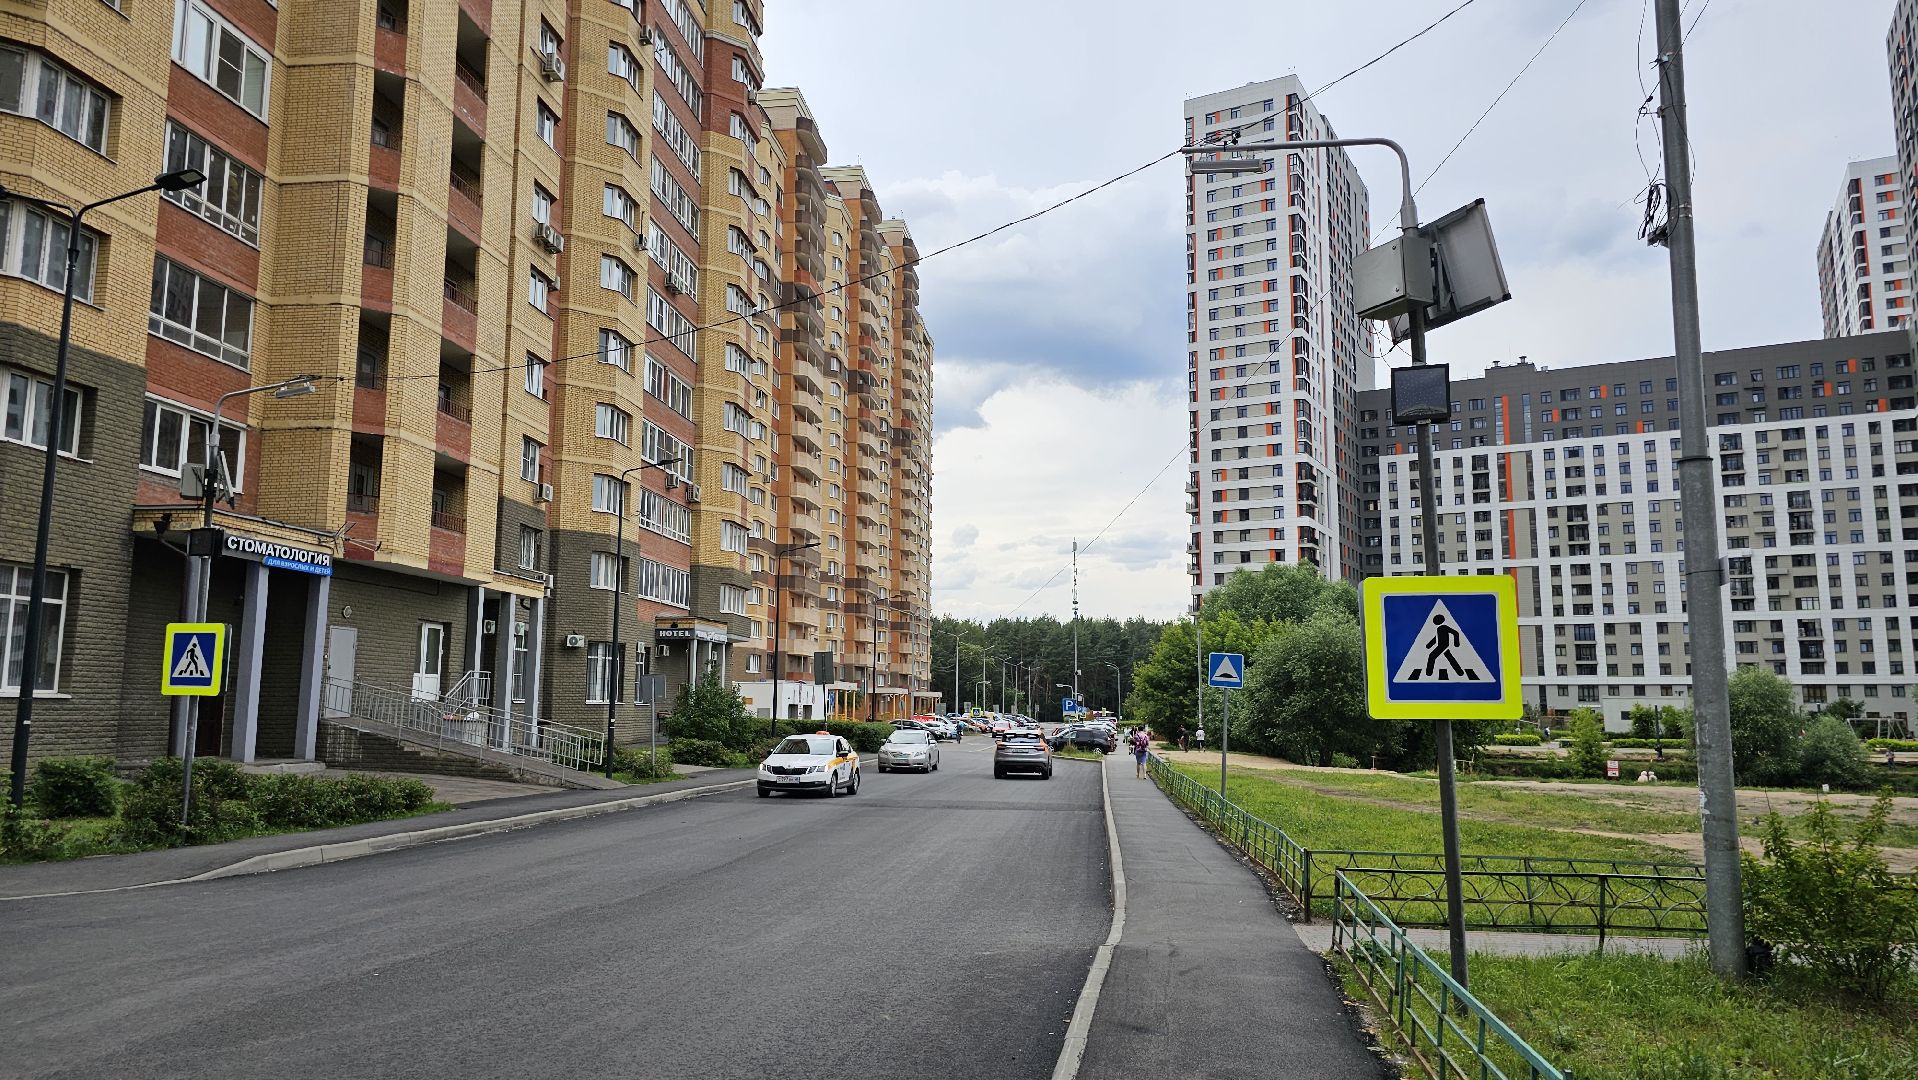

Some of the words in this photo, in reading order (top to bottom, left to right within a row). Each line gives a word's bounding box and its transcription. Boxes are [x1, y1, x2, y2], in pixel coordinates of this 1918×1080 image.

[227, 536, 330, 566] СТОМАТОЛОГИЯ
[281, 561, 310, 572] ВЗРОСЛЫХ
[315, 567, 331, 575] ДЕТЕЙ
[1065, 700, 1073, 710] P
